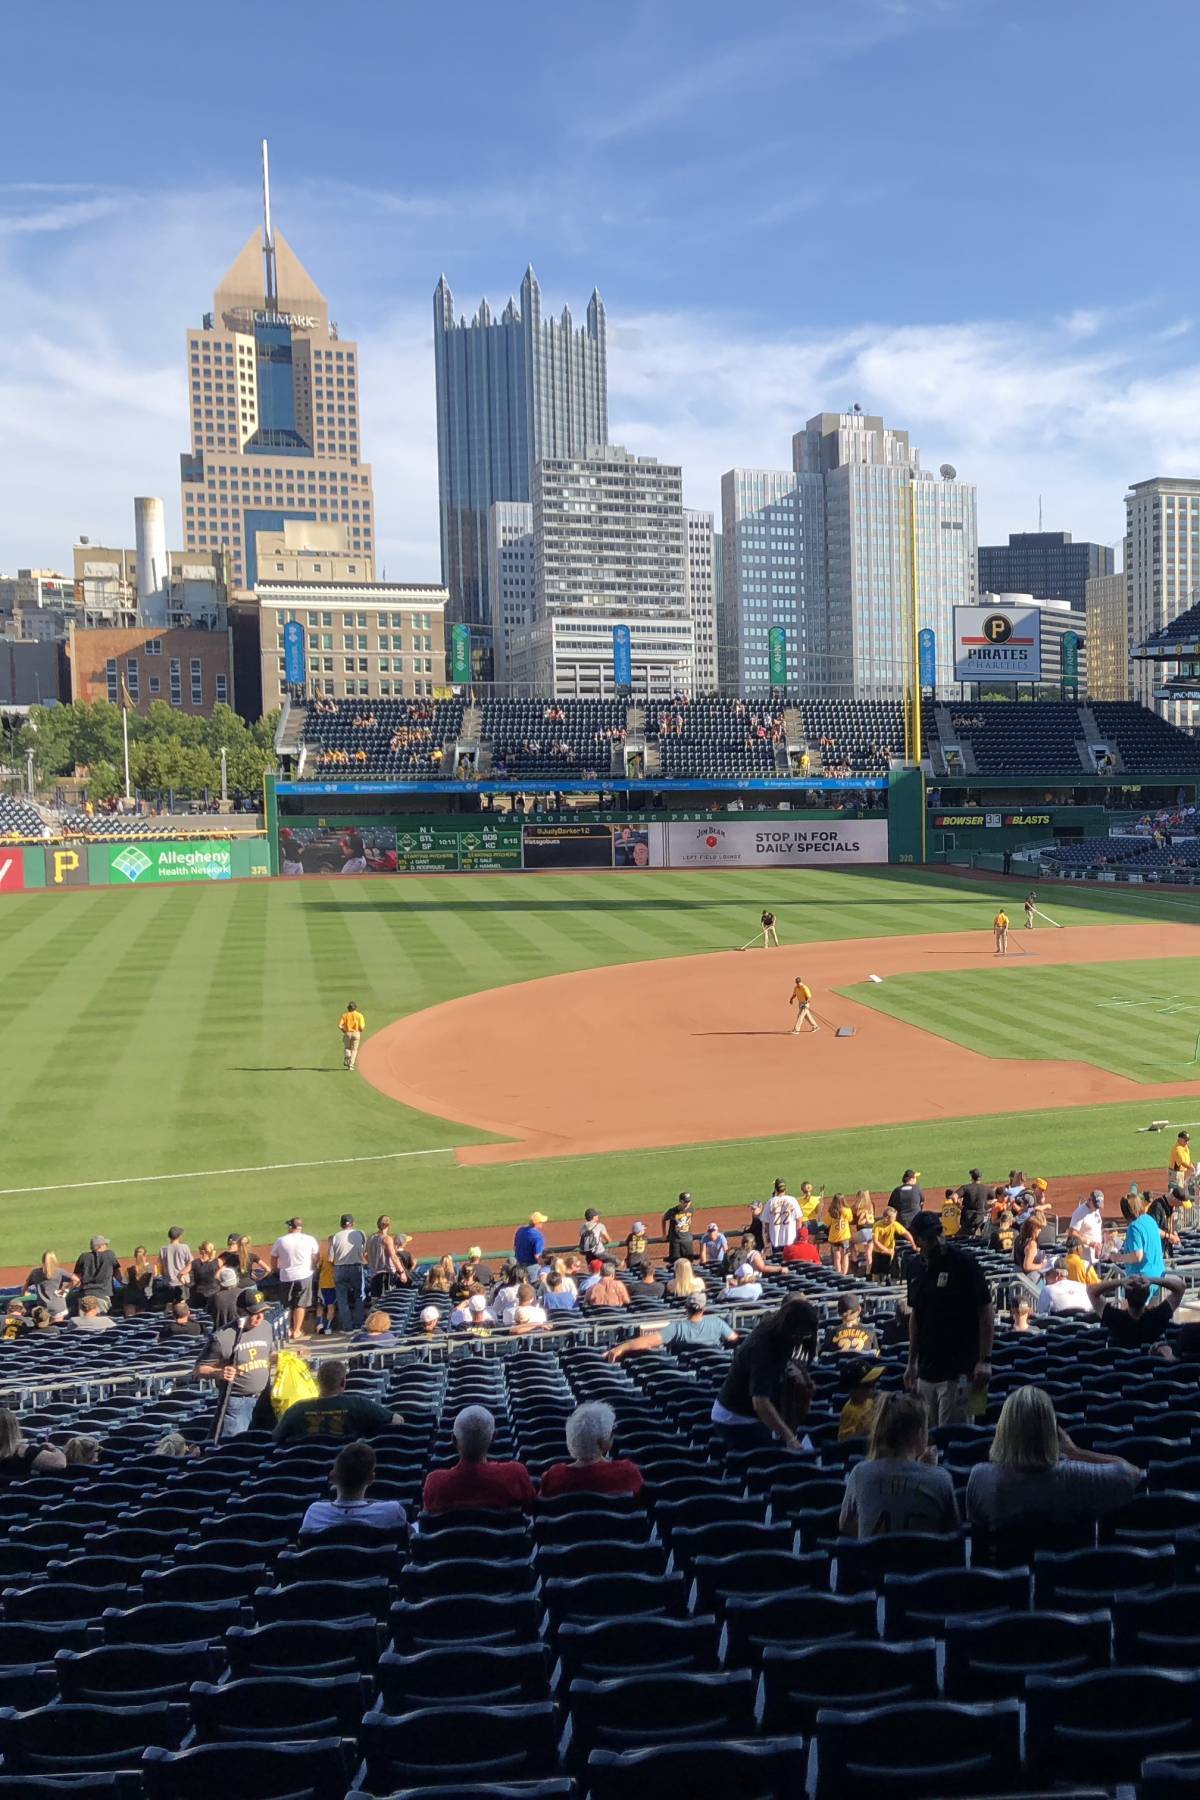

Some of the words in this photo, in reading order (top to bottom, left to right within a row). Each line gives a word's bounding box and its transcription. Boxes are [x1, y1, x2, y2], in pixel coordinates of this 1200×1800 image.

[968, 649, 1028, 660] PIRATES
[968, 661, 1028, 671] CHARITIES
[498, 815, 580, 823] WELCOME
[594, 814, 612, 822] TO
[672, 813, 713, 821] PARK
[943, 816, 984, 826] BOWSER
[1012, 815, 1050, 825] BLASTS
[755, 832, 790, 843] STOP
[794, 832, 807, 842] IN
[812, 831, 838, 842] FOR
[756, 843, 793, 854] DAILY
[797, 841, 860, 853] SPECIALS
[158, 850, 229, 864] Allegheny
[53, 850, 80, 883] P
[158, 866, 189, 877] Health
[191, 865, 231, 875] Network
